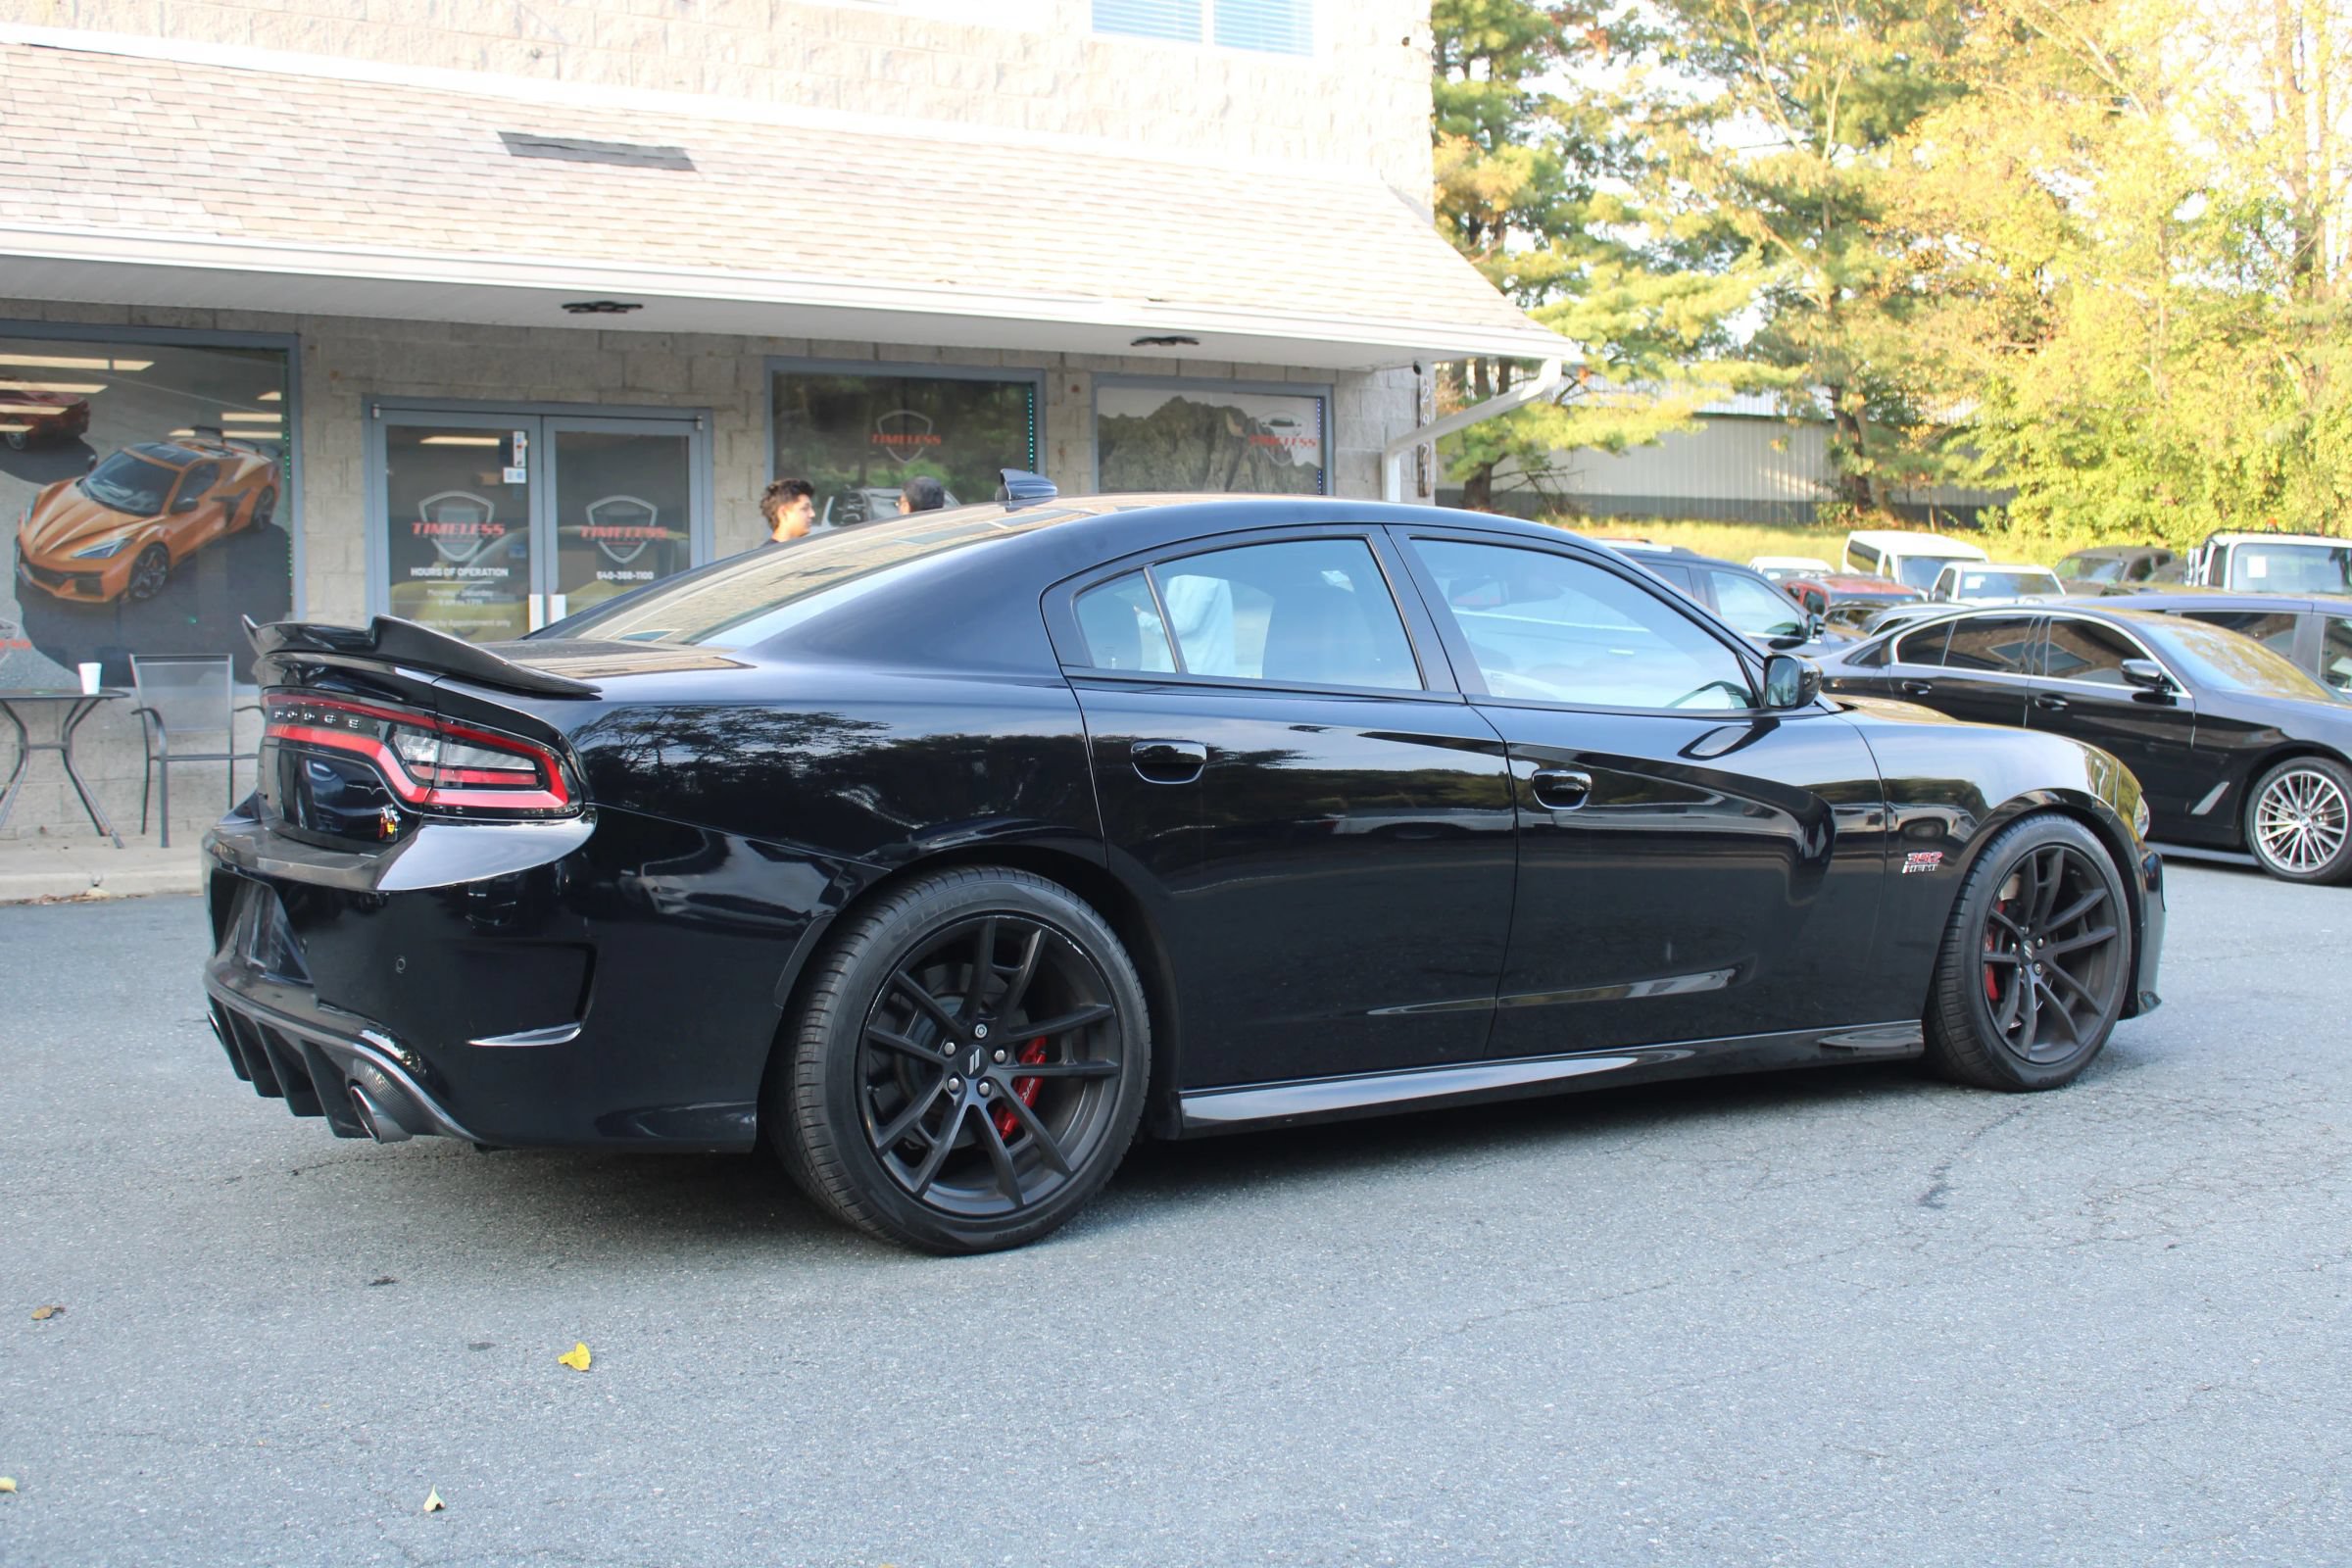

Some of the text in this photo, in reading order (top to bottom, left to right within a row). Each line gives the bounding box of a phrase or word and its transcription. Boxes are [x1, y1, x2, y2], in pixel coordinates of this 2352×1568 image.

[871, 433, 942, 446] TIMELESS
[412, 522, 506, 536] TIMELESS
[580, 525, 668, 539] TIMELESS
[410, 566, 509, 577] HOURS OF OPERATION
[1907, 852, 1944, 863] 392
[1902, 862, 1938, 874] HEMI
